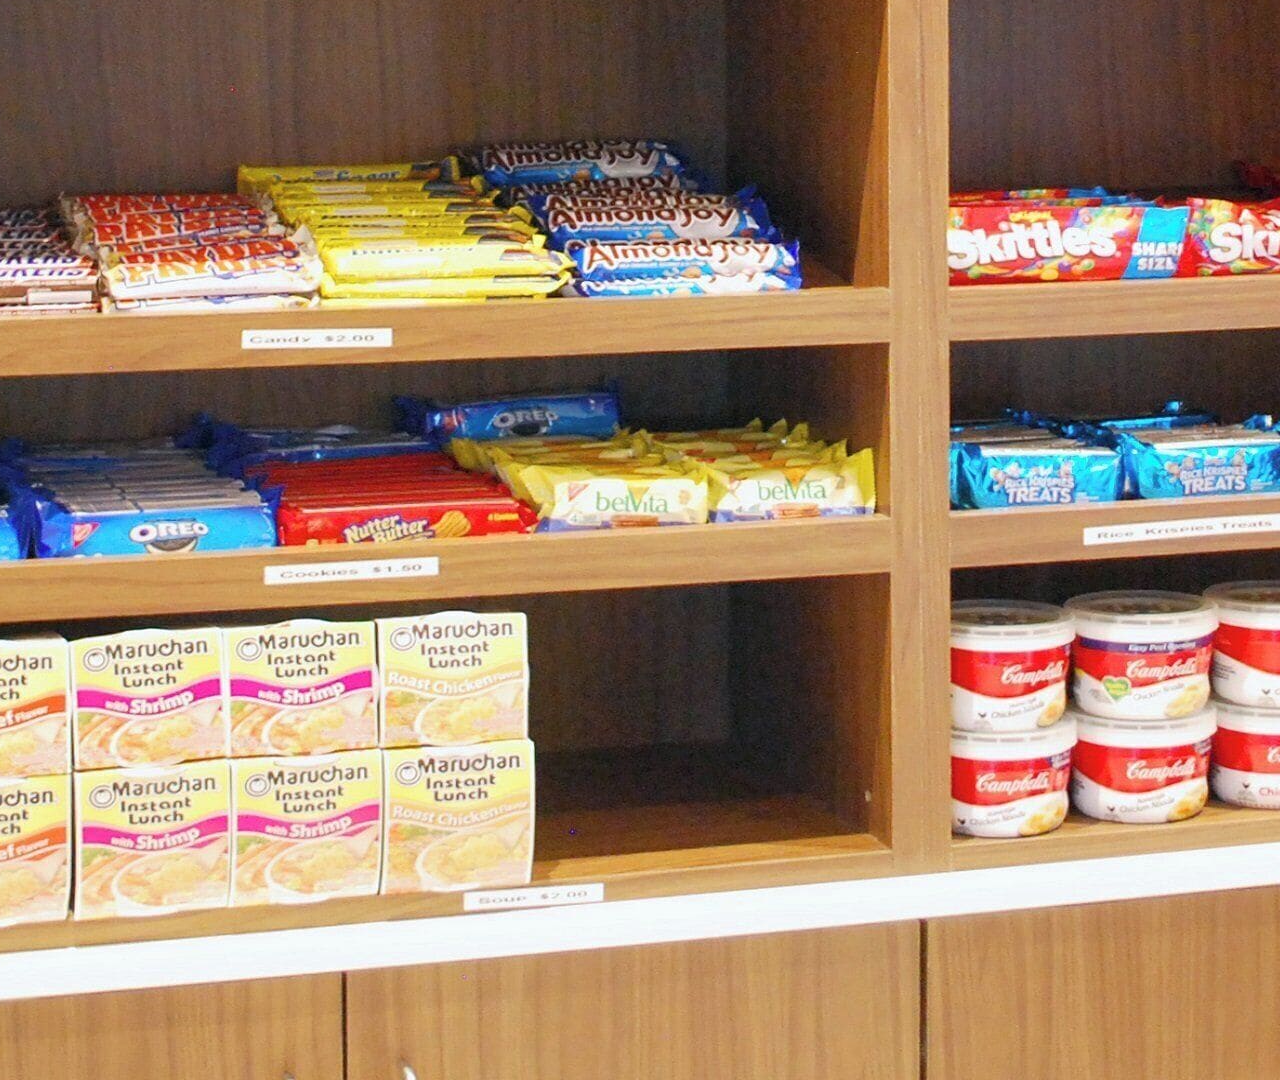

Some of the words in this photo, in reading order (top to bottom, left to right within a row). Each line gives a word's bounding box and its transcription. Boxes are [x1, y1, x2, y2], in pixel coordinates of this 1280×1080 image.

[549, 207, 677, 230] Almond
[947, 219, 1117, 270] Skittles
[585, 242, 711, 270] Almond
[1137, 256, 1178, 271] SIZE
[249, 334, 312, 345] Candy
[323, 333, 376, 344] $2.00
[491, 407, 560, 430] OREO
[757, 480, 827, 502] belVita
[1006, 486, 1072, 504] TREATS
[1182, 475, 1247, 495] TREATS
[595, 491, 670, 514] belVita
[128, 520, 210, 543] OREO
[342, 514, 401, 543] Nutter
[370, 519, 429, 543] Butter
[1097, 530, 1135, 540] Rice
[1144, 523, 1215, 536] Krispies
[1220, 519, 1274, 530] Treats
[279, 567, 360, 580] Cookies
[372, 563, 424, 574] $1.50
[258, 630, 360, 650] Maruchan
[412, 621, 513, 641] Maruchan
[105, 638, 208, 660] Maruchan
[420, 641, 490, 656] Instant
[1127, 642, 1148, 652] Easy
[1149, 642, 1168, 652] Peel
[113, 659, 185, 675] Instant
[267, 651, 337, 666] Instant
[428, 656, 483, 669] Lunch
[122, 674, 177, 688] Lunch
[275, 665, 329, 678] Lunch
[281, 680, 346, 705] Shrimp
[388, 671, 433, 691] Roast
[433, 674, 493, 695] Chicken
[129, 690, 195, 716] Shrimp
[1132, 689, 1162, 702] Chicken
[418, 754, 521, 774] Maruchan
[112, 775, 216, 796] Maruchan
[267, 765, 369, 786] Maruchan
[393, 804, 437, 824] Roast
[438, 807, 500, 827] Chicken
[288, 815, 353, 840] Shrimp
[135, 827, 201, 851] Shrimp
